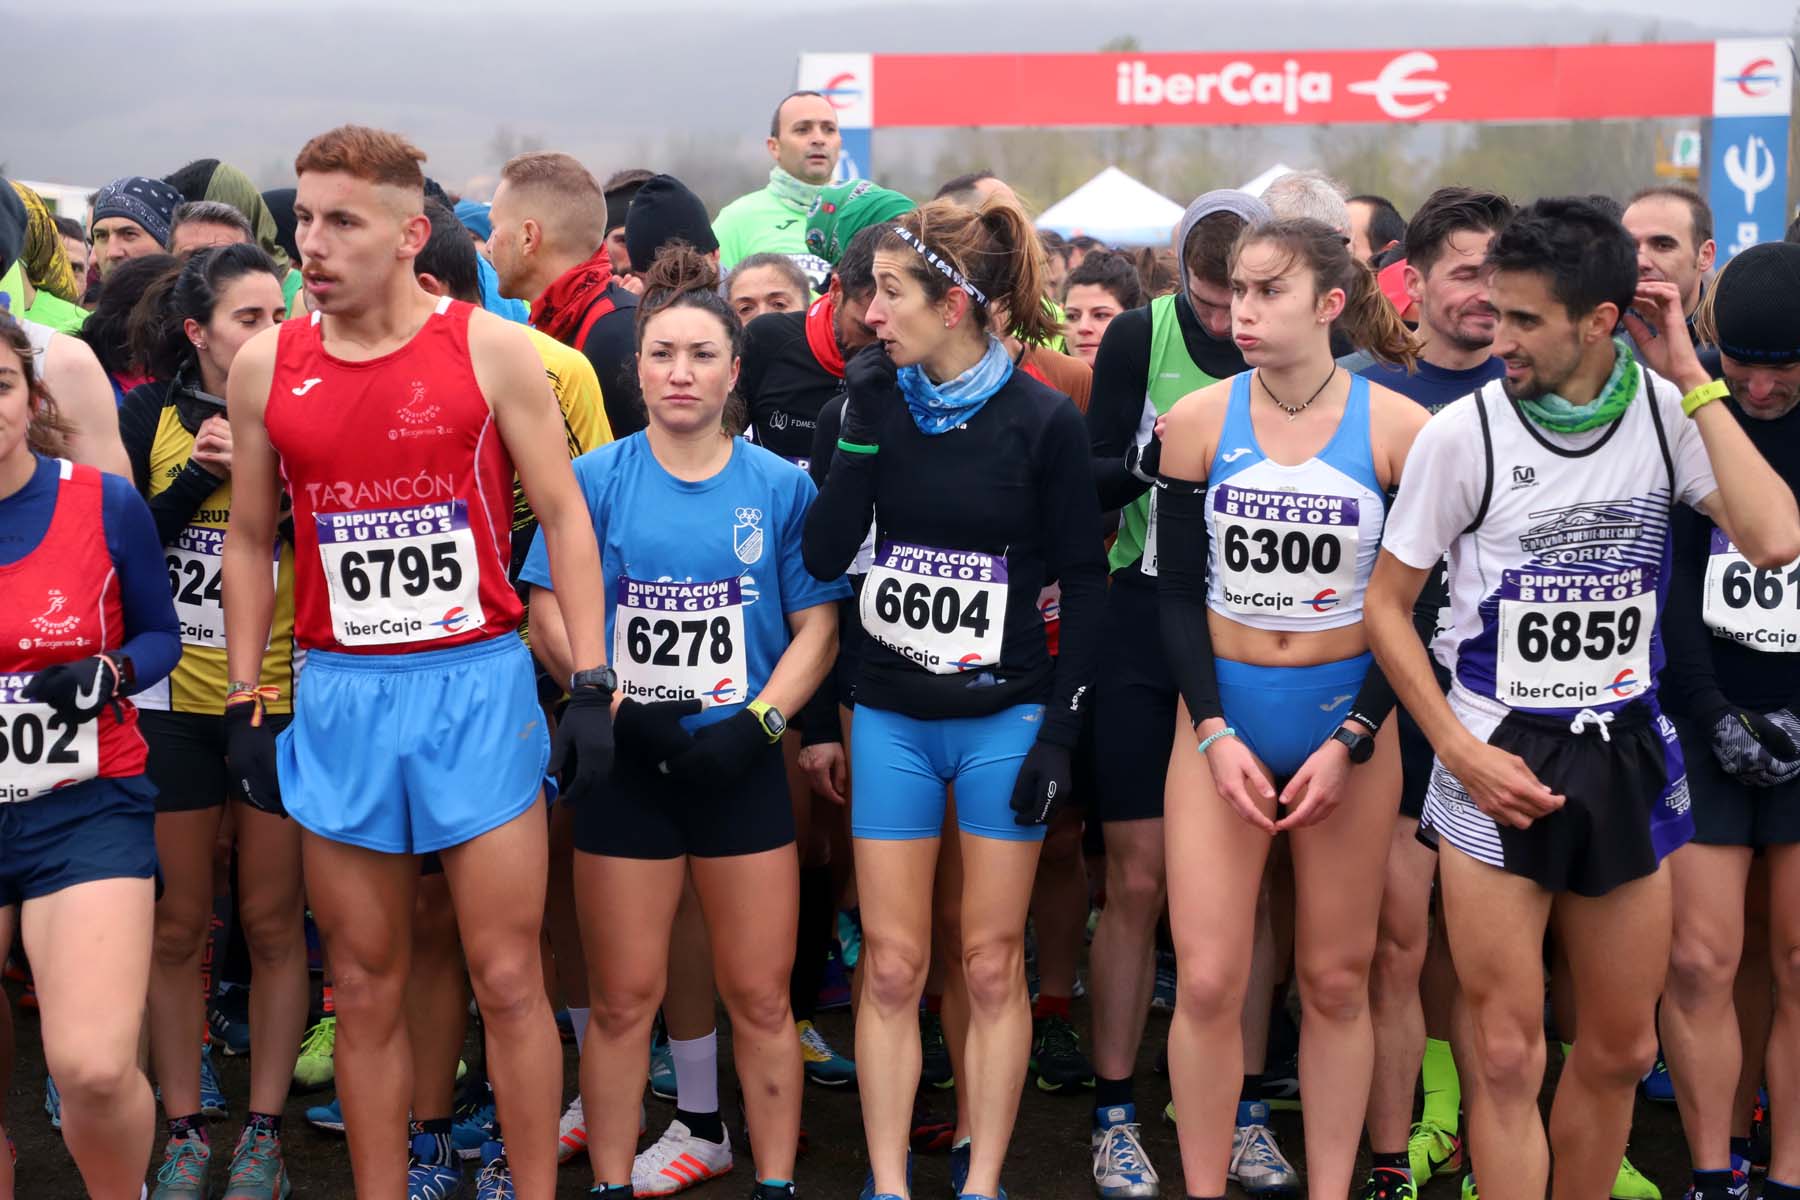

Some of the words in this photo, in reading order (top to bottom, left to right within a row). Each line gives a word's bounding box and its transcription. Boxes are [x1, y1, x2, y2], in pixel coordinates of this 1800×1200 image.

[1117, 60, 1332, 115] iberCaja
[305, 470, 454, 510] TARANCÓN
[1227, 489, 1342, 511] DIPUTACIÓN
[333, 505, 449, 528] DIPUTACIÓN
[1226, 502, 1342, 524] BURGOS
[334, 518, 452, 542] BURGOS
[891, 545, 992, 567] DIPUTACIÓN
[1225, 525, 1341, 574] 6300
[1540, 546, 1624, 566] SORIA
[340, 541, 462, 602] 6795
[885, 556, 992, 582] BURGOS
[1519, 568, 1642, 588] DIPUTACIÓN
[628, 582, 729, 598] DIPUTACIÓN
[1519, 581, 1642, 602] BURGOS
[627, 594, 729, 611] BURGOS
[876, 577, 990, 638] 6604
[345, 618, 422, 637] iberCaja
[1517, 606, 1641, 663] 6859
[627, 616, 733, 667] 6278
[622, 680, 695, 701] iberCaja
[1510, 681, 1598, 701] iberCaja
